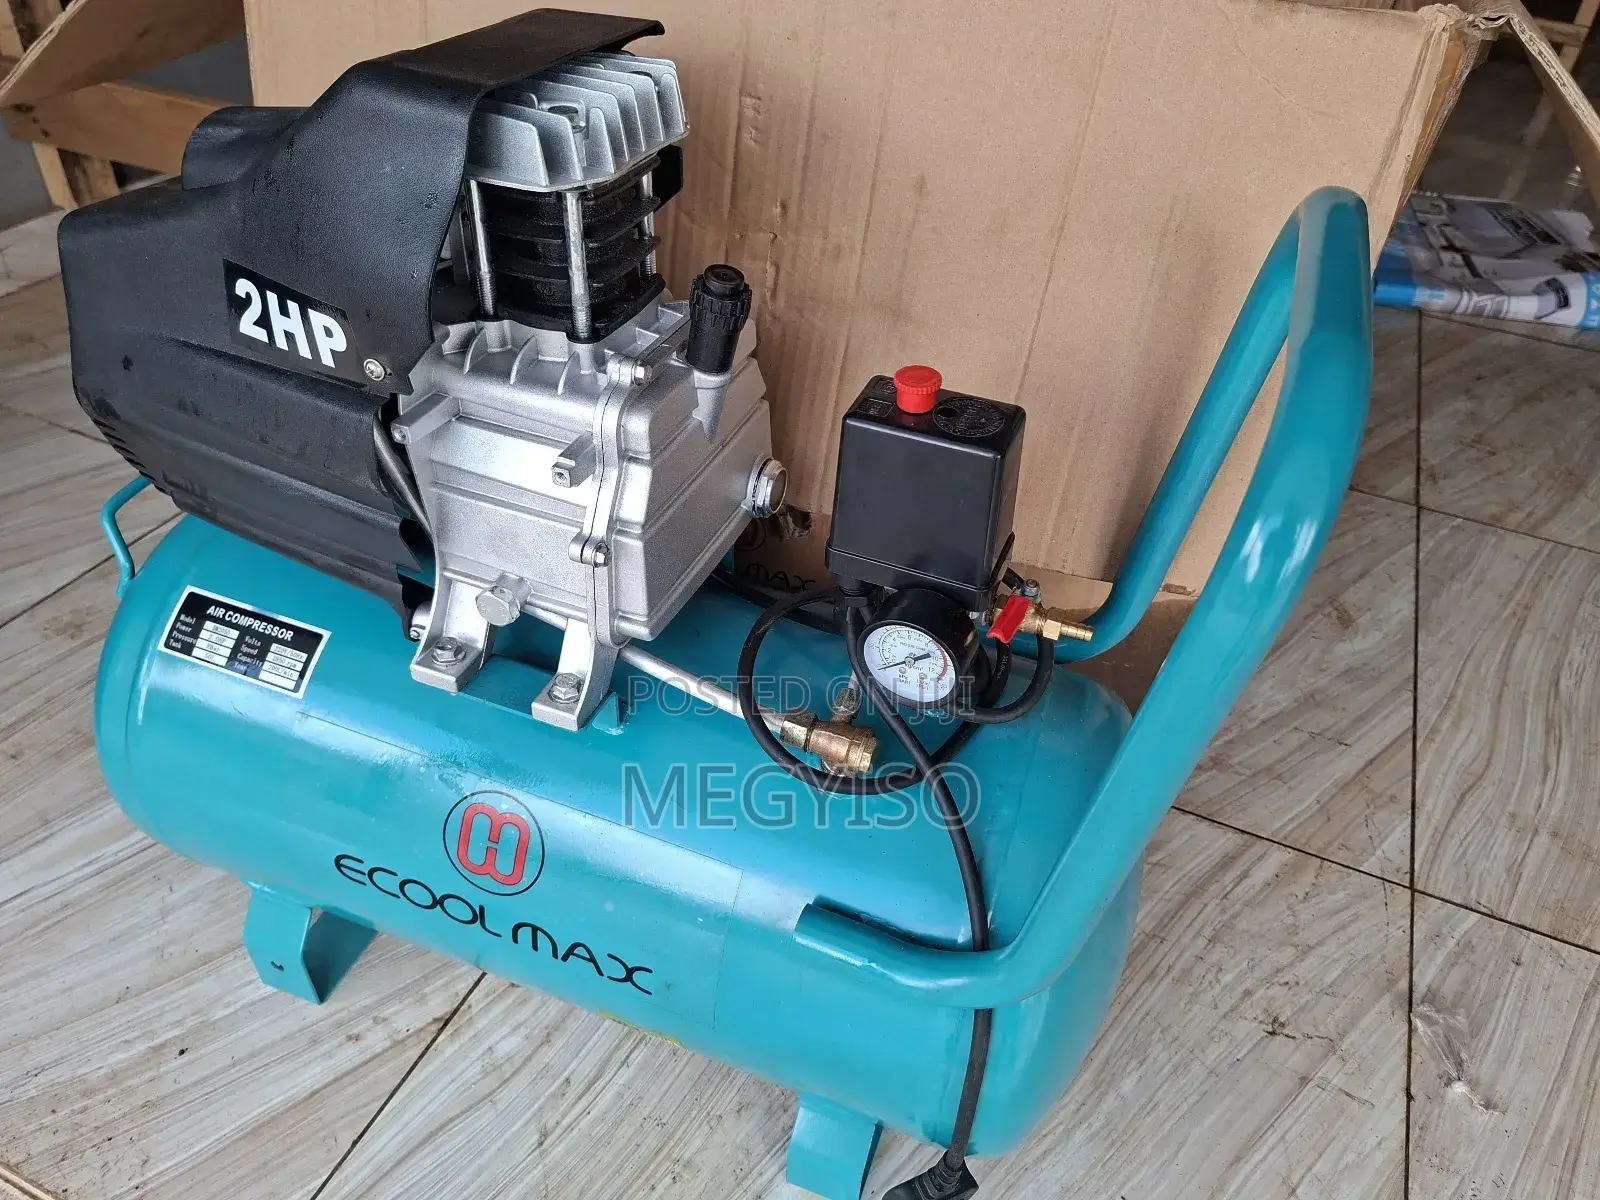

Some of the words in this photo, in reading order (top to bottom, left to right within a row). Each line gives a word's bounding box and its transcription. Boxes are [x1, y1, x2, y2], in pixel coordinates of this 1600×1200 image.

[235, 278, 347, 368] 2HP
[179, 613, 197, 625] Model
[206, 605, 226, 619] AIR
[224, 610, 295, 642] COMPRESSOR
[175, 622, 193, 633] Power
[169, 638, 183, 649] Tank
[171, 630, 197, 645] Pressure
[244, 635, 262, 647] Volts
[240, 644, 259, 656] Speed
[236, 652, 264, 668] Capacity
[334, 853, 502, 938] ECOOL
[511, 921, 653, 995] MAX
